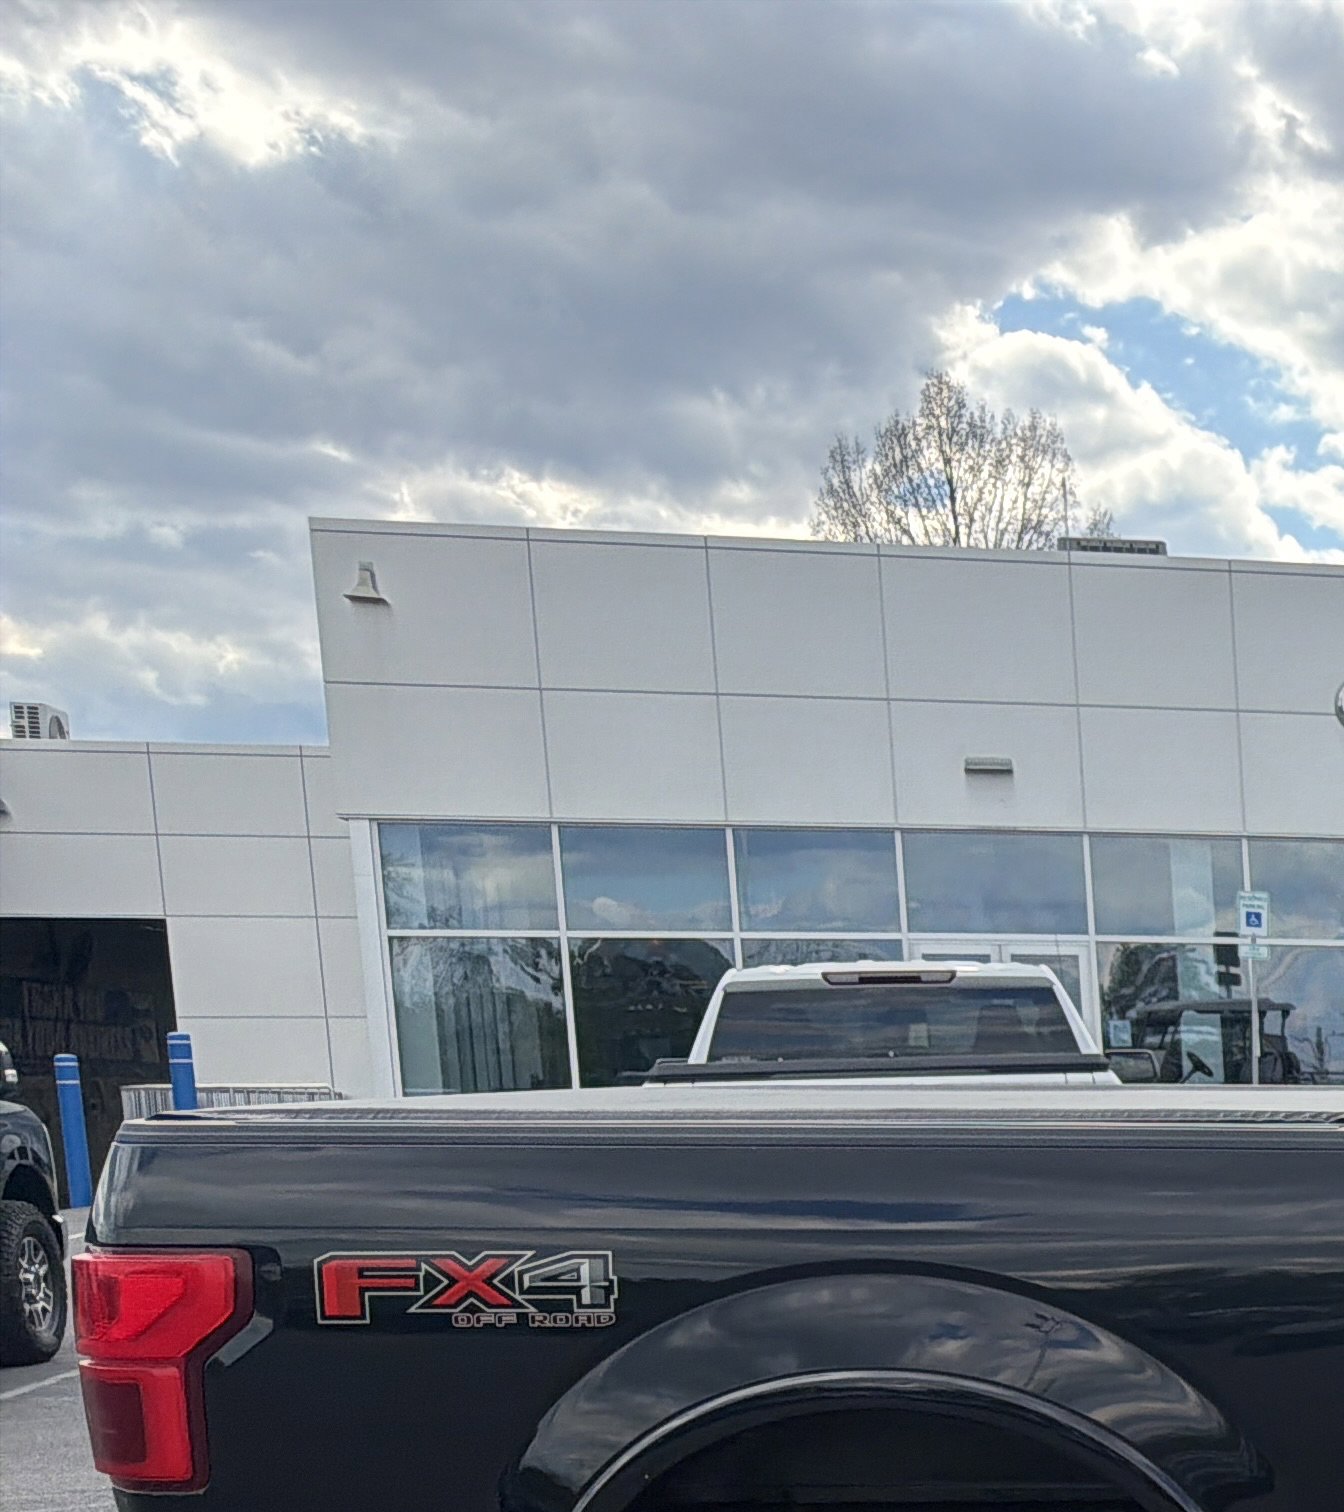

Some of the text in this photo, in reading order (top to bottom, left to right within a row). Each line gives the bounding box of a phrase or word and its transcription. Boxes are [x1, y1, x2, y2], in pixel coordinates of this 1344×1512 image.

[314, 1250, 618, 1325] FX4
[452, 1312, 616, 1329] OFF ROAD
